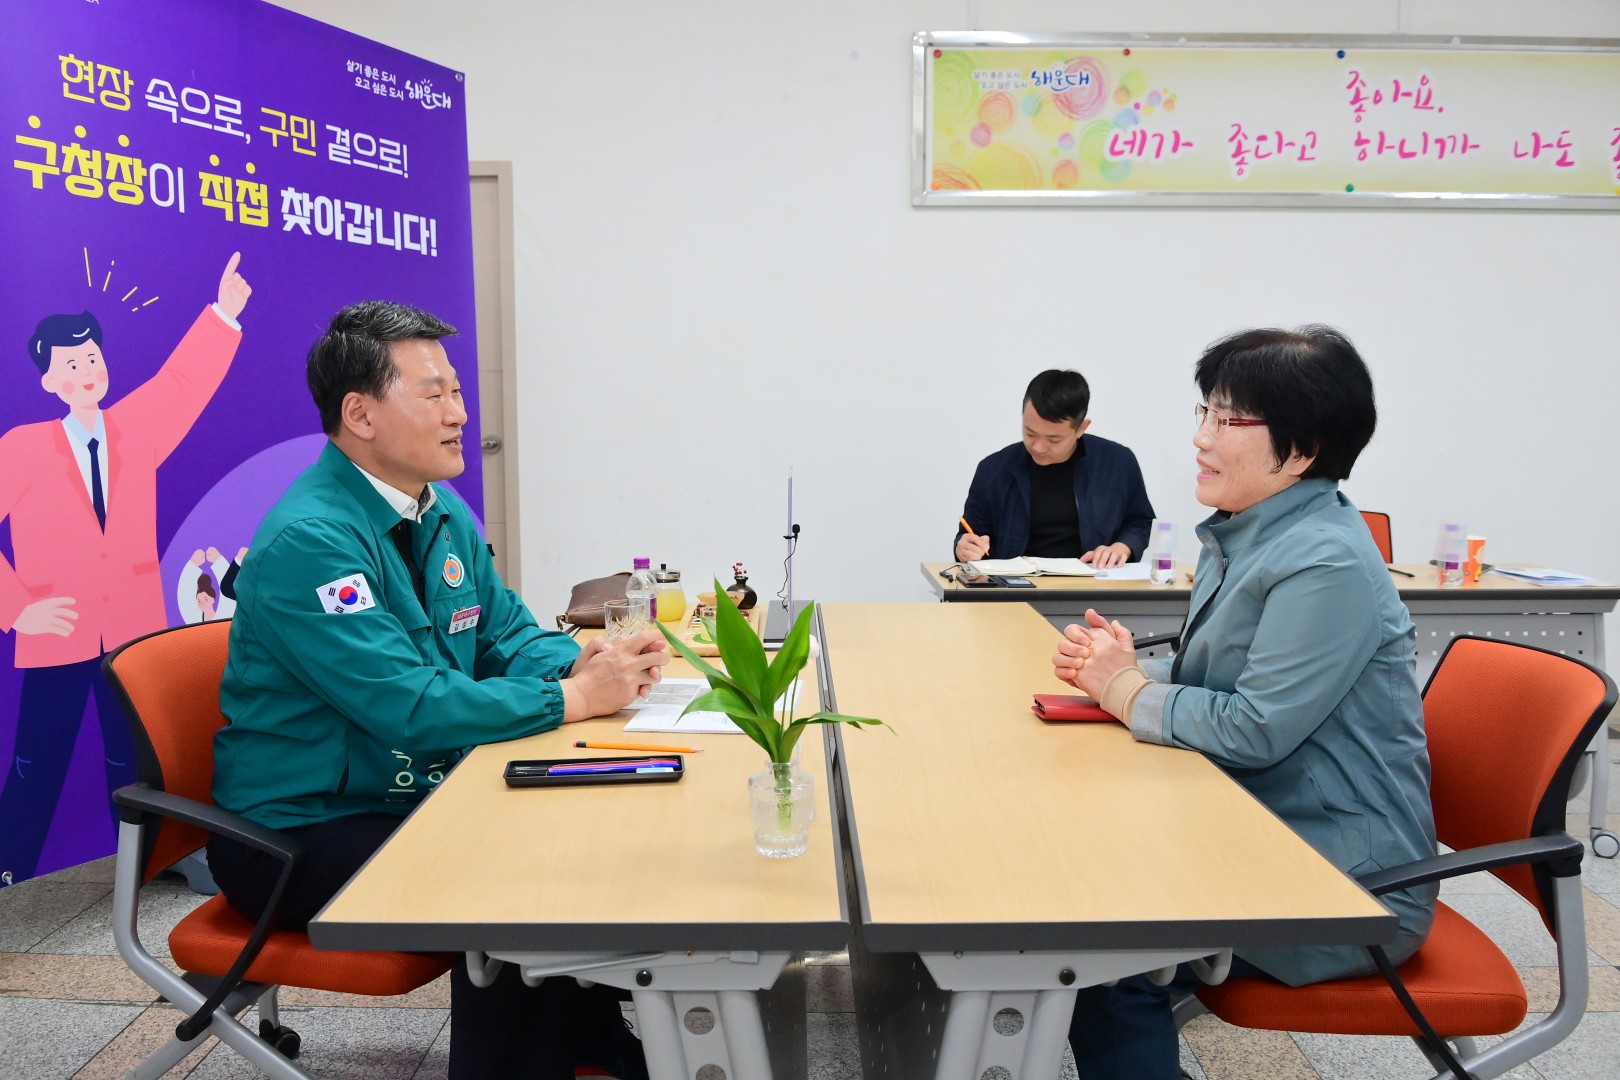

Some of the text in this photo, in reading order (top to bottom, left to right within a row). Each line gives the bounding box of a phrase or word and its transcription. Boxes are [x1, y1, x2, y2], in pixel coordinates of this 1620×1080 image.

[346, 60, 397, 85] 살기 좋은 도시
[355, 77, 404, 102] 오고 싶은 도시
[1031, 69, 1090, 92] 해운대
[58, 53, 409, 178] 현장 속으로, 구민 곁으로!
[405, 79, 452, 110] 해운대
[1346, 70, 1444, 123] 좋아요.
[1109, 129, 1194, 159] 네가
[1228, 123, 1317, 176] 좋다고
[1354, 131, 1480, 161] 하니까
[1514, 130, 1575, 167] 나도
[13, 132, 438, 257] 구청장이 직접 찾아갑니다!
